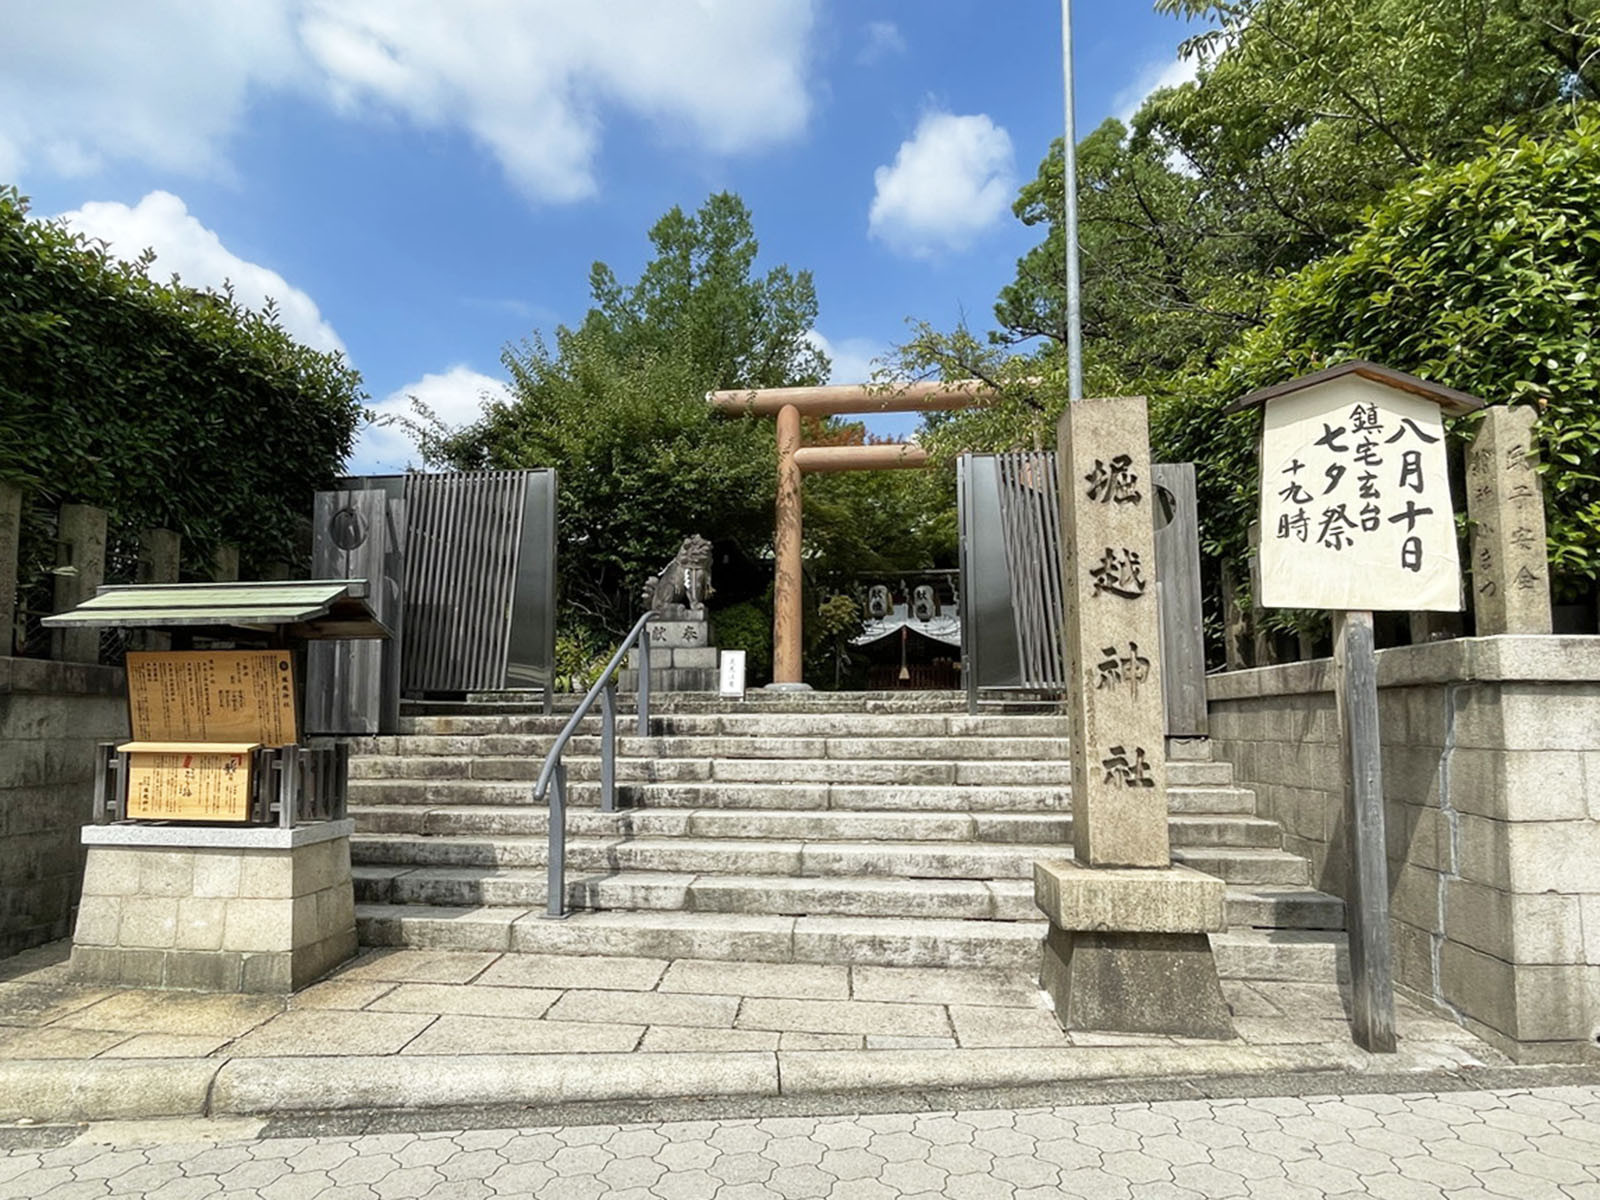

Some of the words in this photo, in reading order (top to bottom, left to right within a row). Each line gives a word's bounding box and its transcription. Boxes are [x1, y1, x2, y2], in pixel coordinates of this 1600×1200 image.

[1276, 459, 1314, 543] 十九時
[1313, 423, 1359, 551] 七夕祭
[1384, 418, 1441, 573] 八月十日
[1084, 453, 1155, 788] 堀越神社
